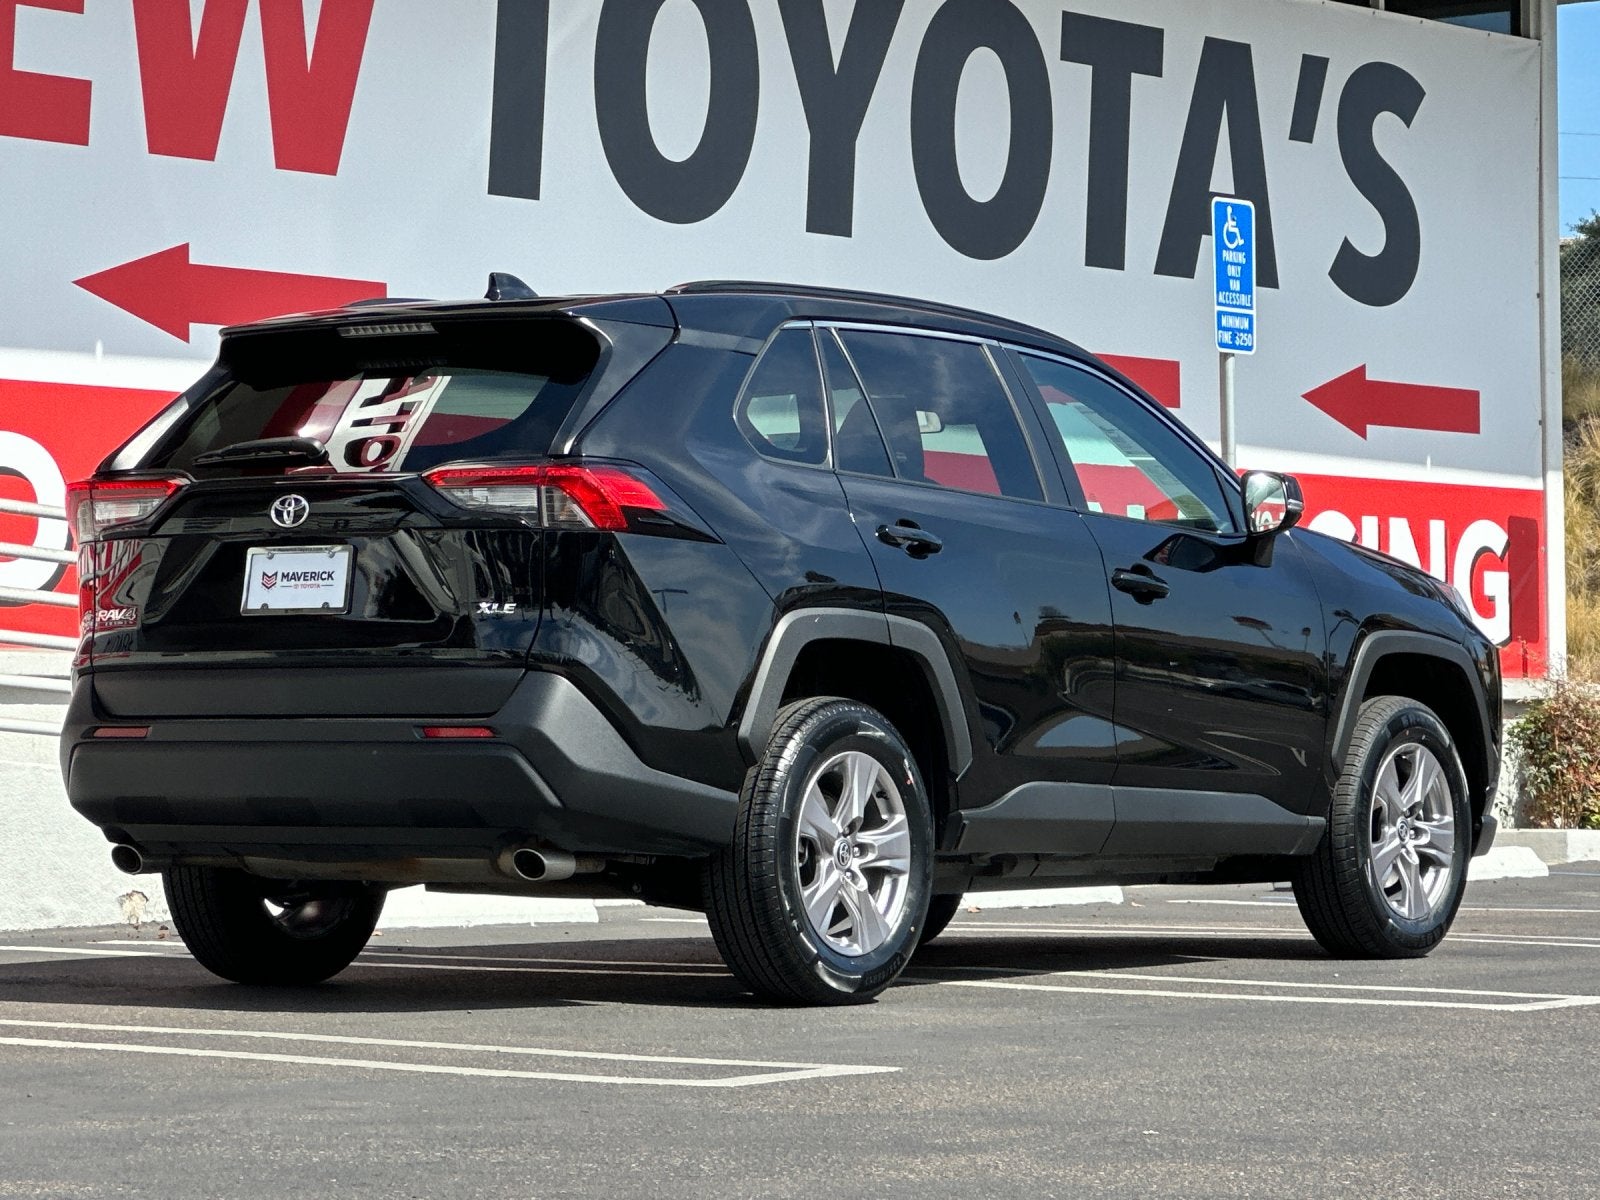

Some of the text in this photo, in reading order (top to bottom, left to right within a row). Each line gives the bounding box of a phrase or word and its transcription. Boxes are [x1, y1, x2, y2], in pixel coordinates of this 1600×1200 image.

[1222, 250, 1247, 264] PARKING
[1227, 264, 1242, 277] ONLY
[1229, 279, 1241, 291] VAN
[1218, 291, 1252, 307] ACCESSIBLE
[1221, 314, 1249, 330] MINIMUM
[1218, 330, 1252, 346] FINE $250
[280, 571, 336, 582] MAVERICK
[98, 607, 137, 621] RAV4
[476, 602, 517, 614] XLE
